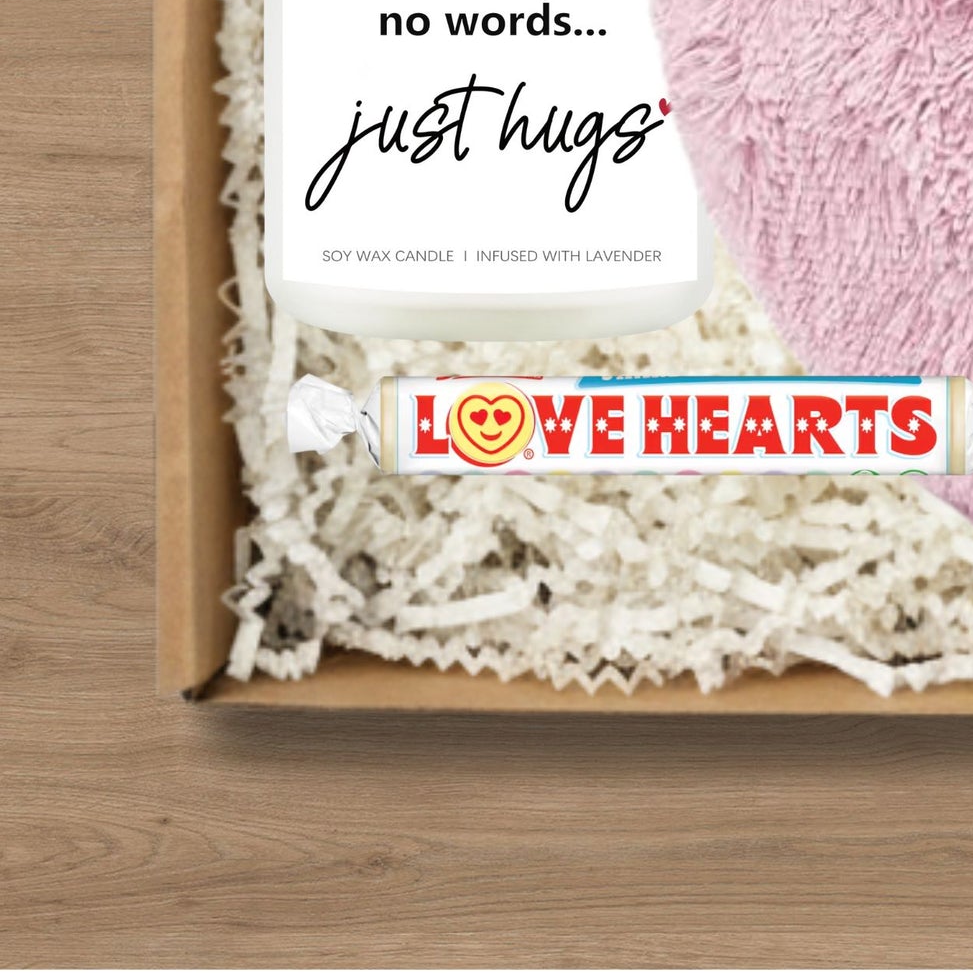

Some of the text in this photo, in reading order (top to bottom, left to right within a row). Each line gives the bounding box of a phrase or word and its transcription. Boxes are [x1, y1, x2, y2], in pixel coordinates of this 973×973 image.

[380, 2, 607, 37] no words...
[304, 73, 665, 214] just hugs
[322, 249, 662, 263] SOY WAX CANDLE INFUSED WITH LAVENDER
[640, 394, 938, 457] HEARTS
